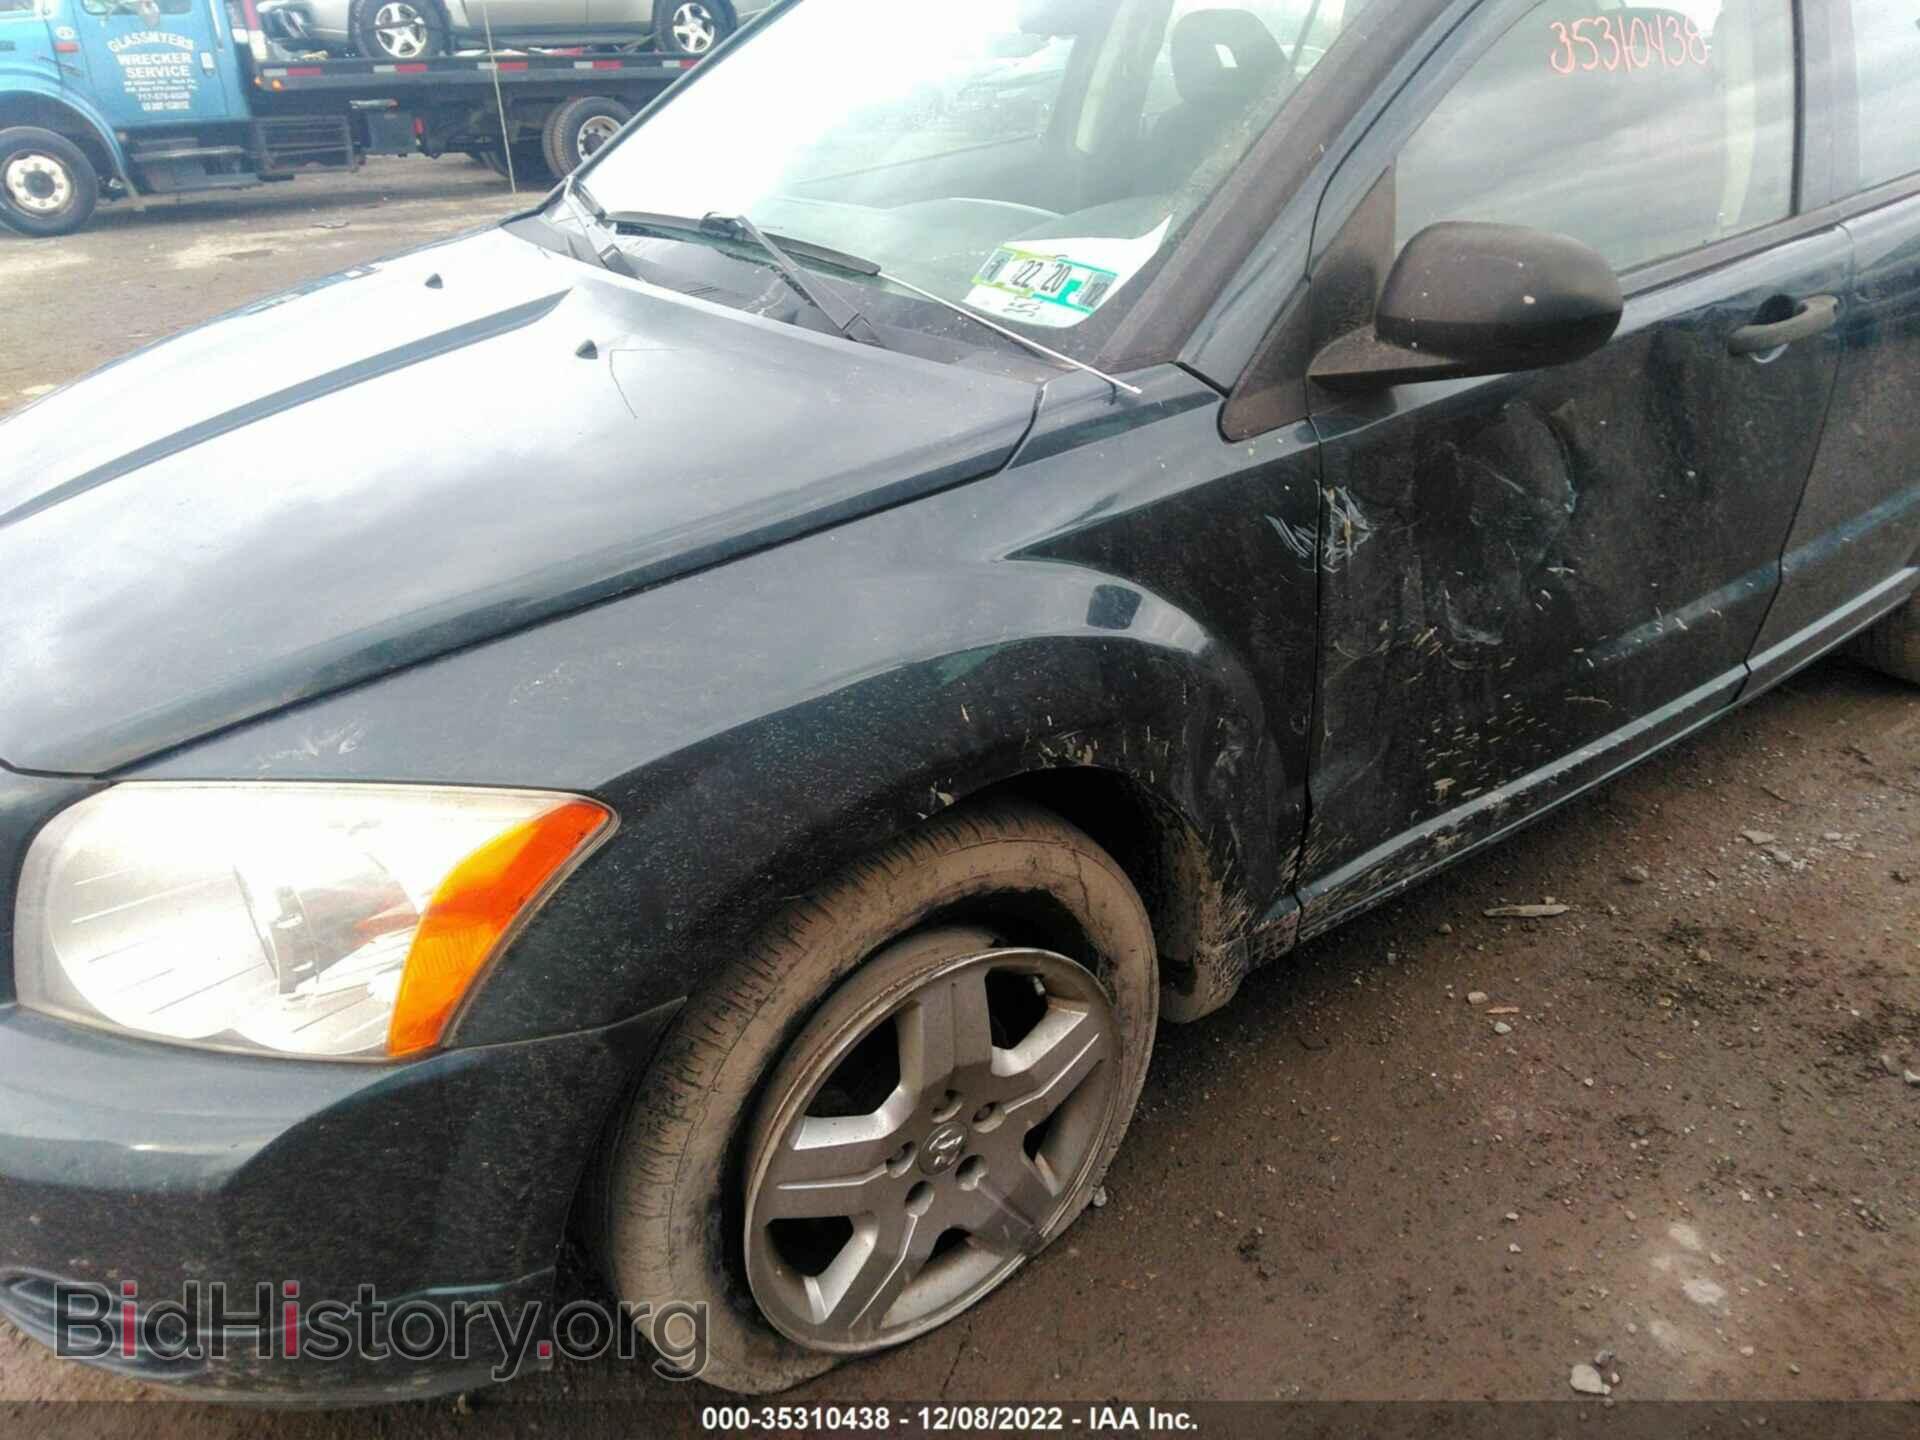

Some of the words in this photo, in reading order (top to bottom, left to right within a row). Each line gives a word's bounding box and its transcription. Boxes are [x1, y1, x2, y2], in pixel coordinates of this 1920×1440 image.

[1549, 14, 1709, 74] 35310438
[116, 52, 193, 66] WRECKER
[126, 65, 191, 79] SERVICE
[1011, 259, 1045, 289] 22
[1040, 263, 1073, 294] 20
